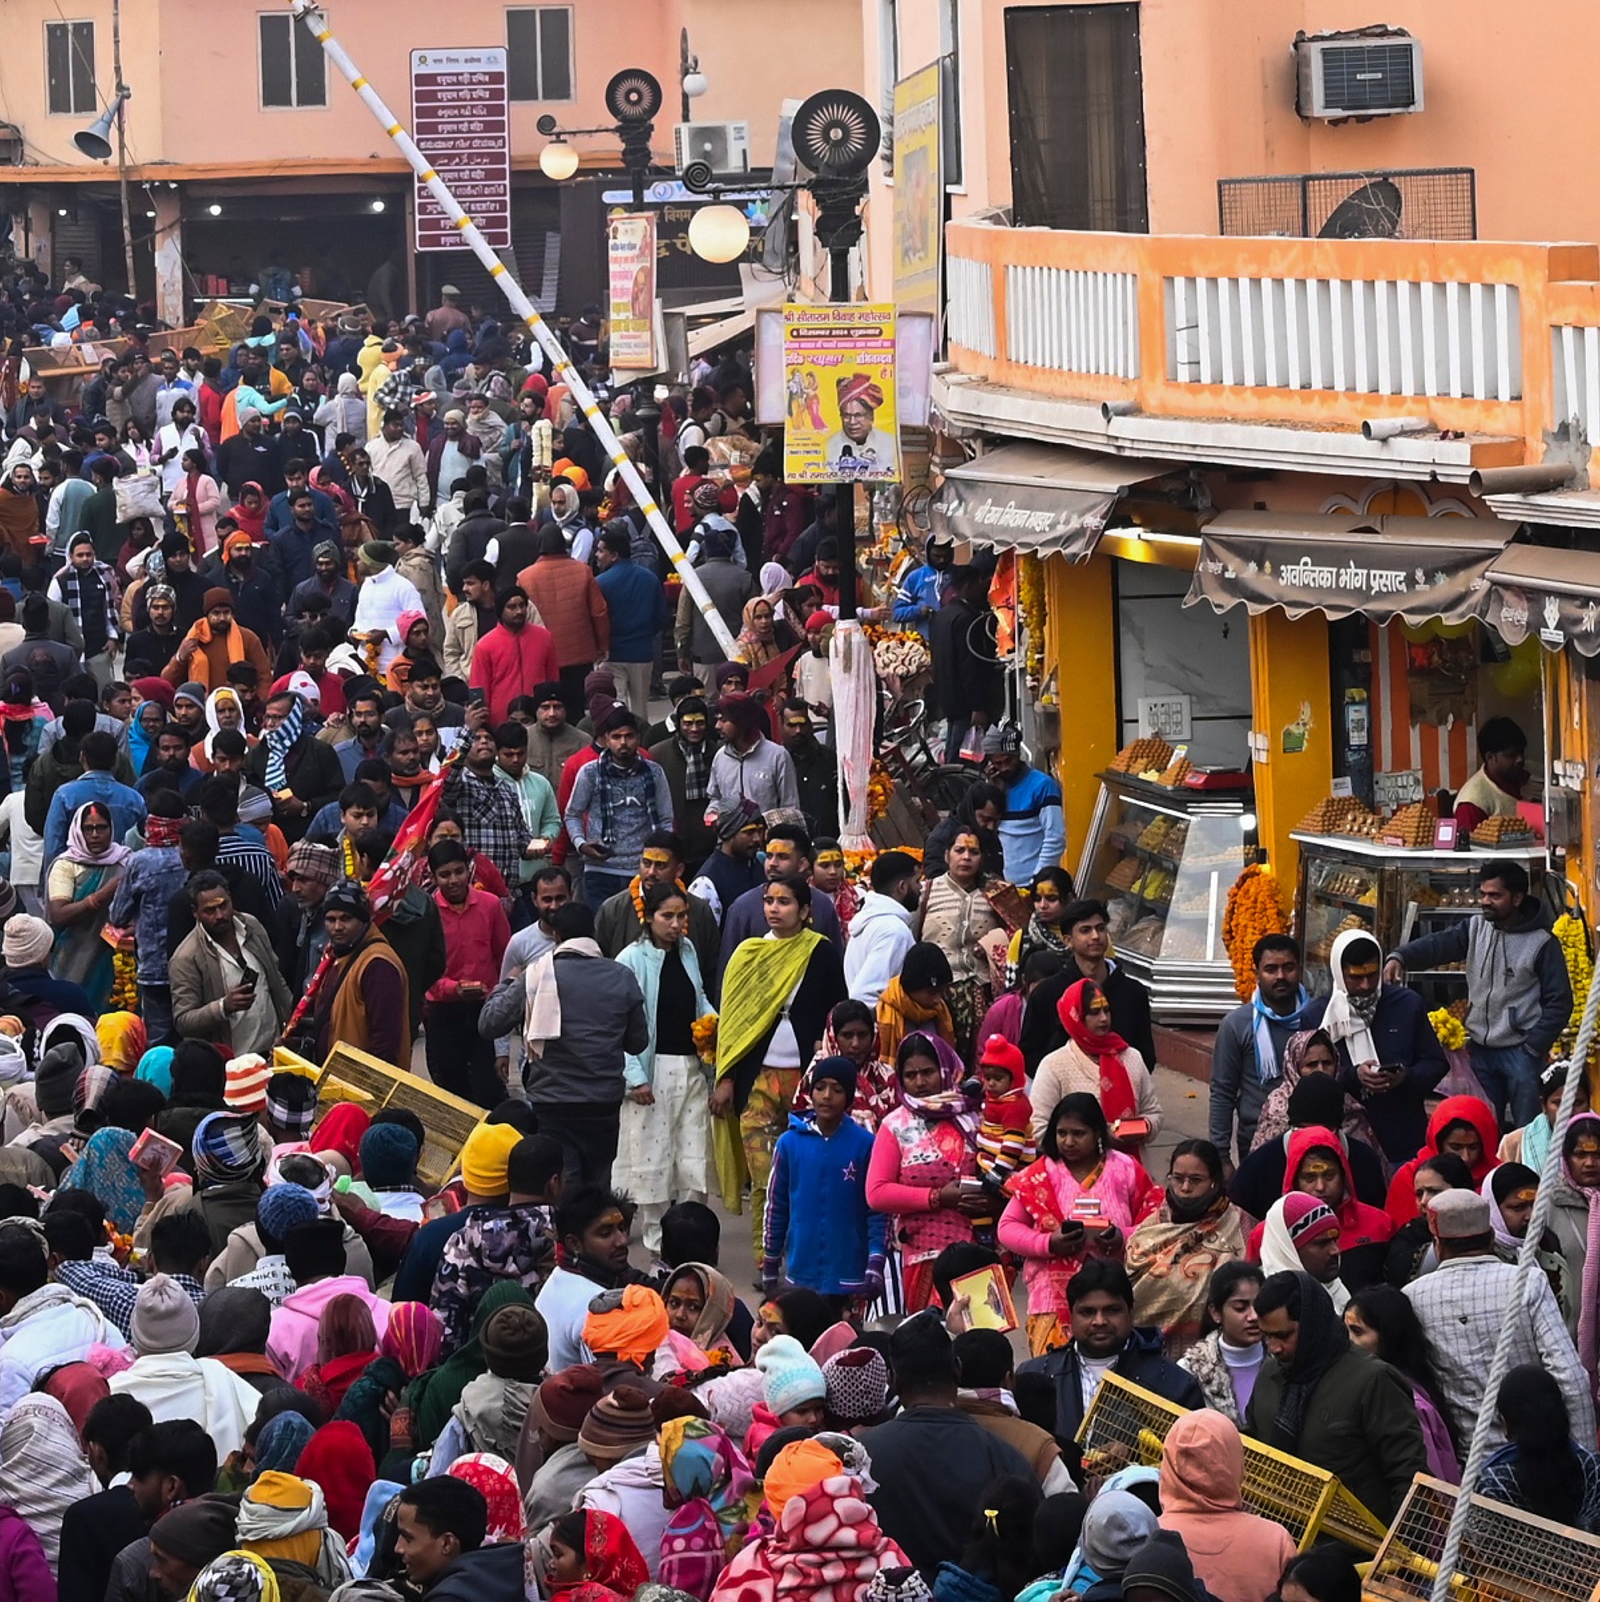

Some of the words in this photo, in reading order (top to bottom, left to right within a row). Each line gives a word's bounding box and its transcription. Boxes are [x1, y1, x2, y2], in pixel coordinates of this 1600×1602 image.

[1278, 555, 1338, 589] अवन्तिका
[1338, 559, 1367, 591] भोग
[1369, 567, 1408, 595] प्रसाद
[1291, 1204, 1333, 1239] NIK
